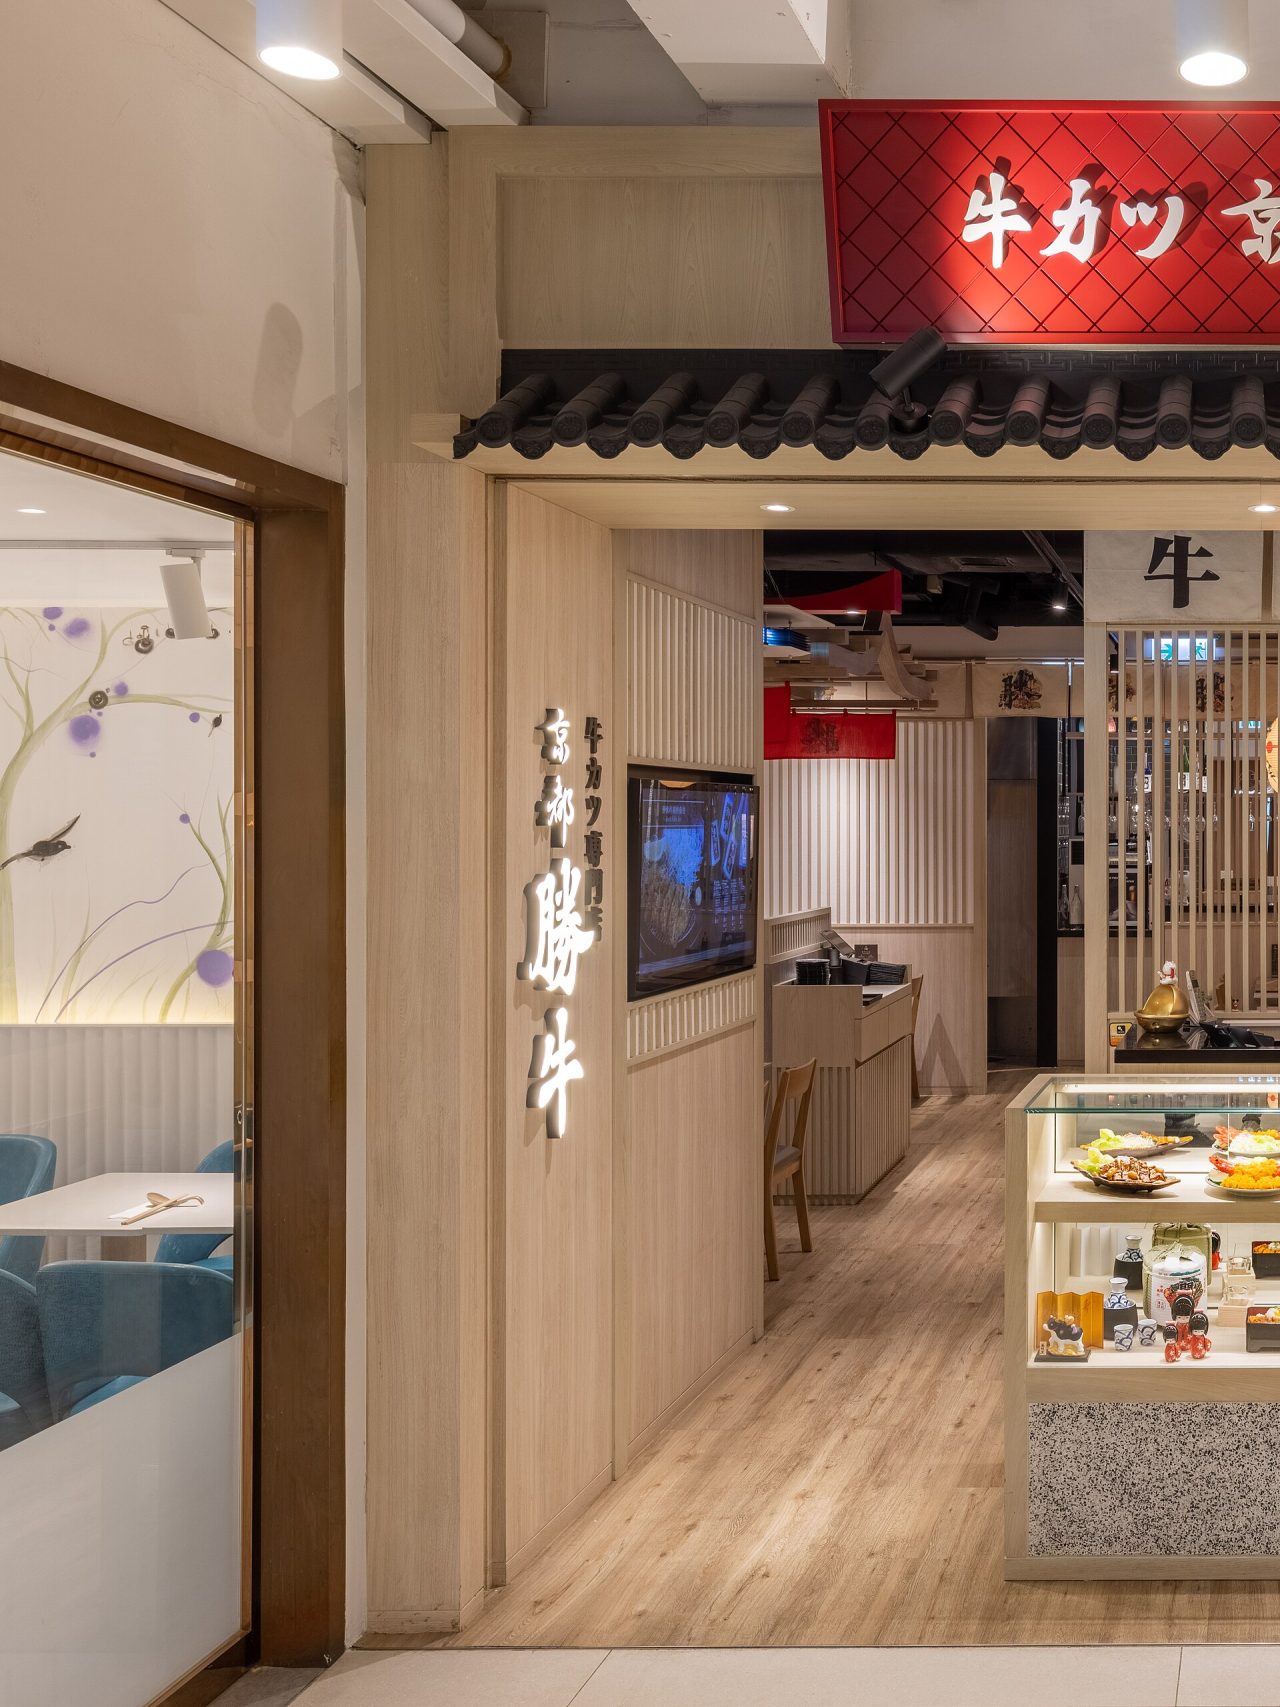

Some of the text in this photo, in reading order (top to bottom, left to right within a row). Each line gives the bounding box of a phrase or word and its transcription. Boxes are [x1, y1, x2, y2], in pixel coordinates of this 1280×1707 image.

[962, 172, 1184, 269] 牛カツ
[520, 708, 594, 1139] 京都勝牛
